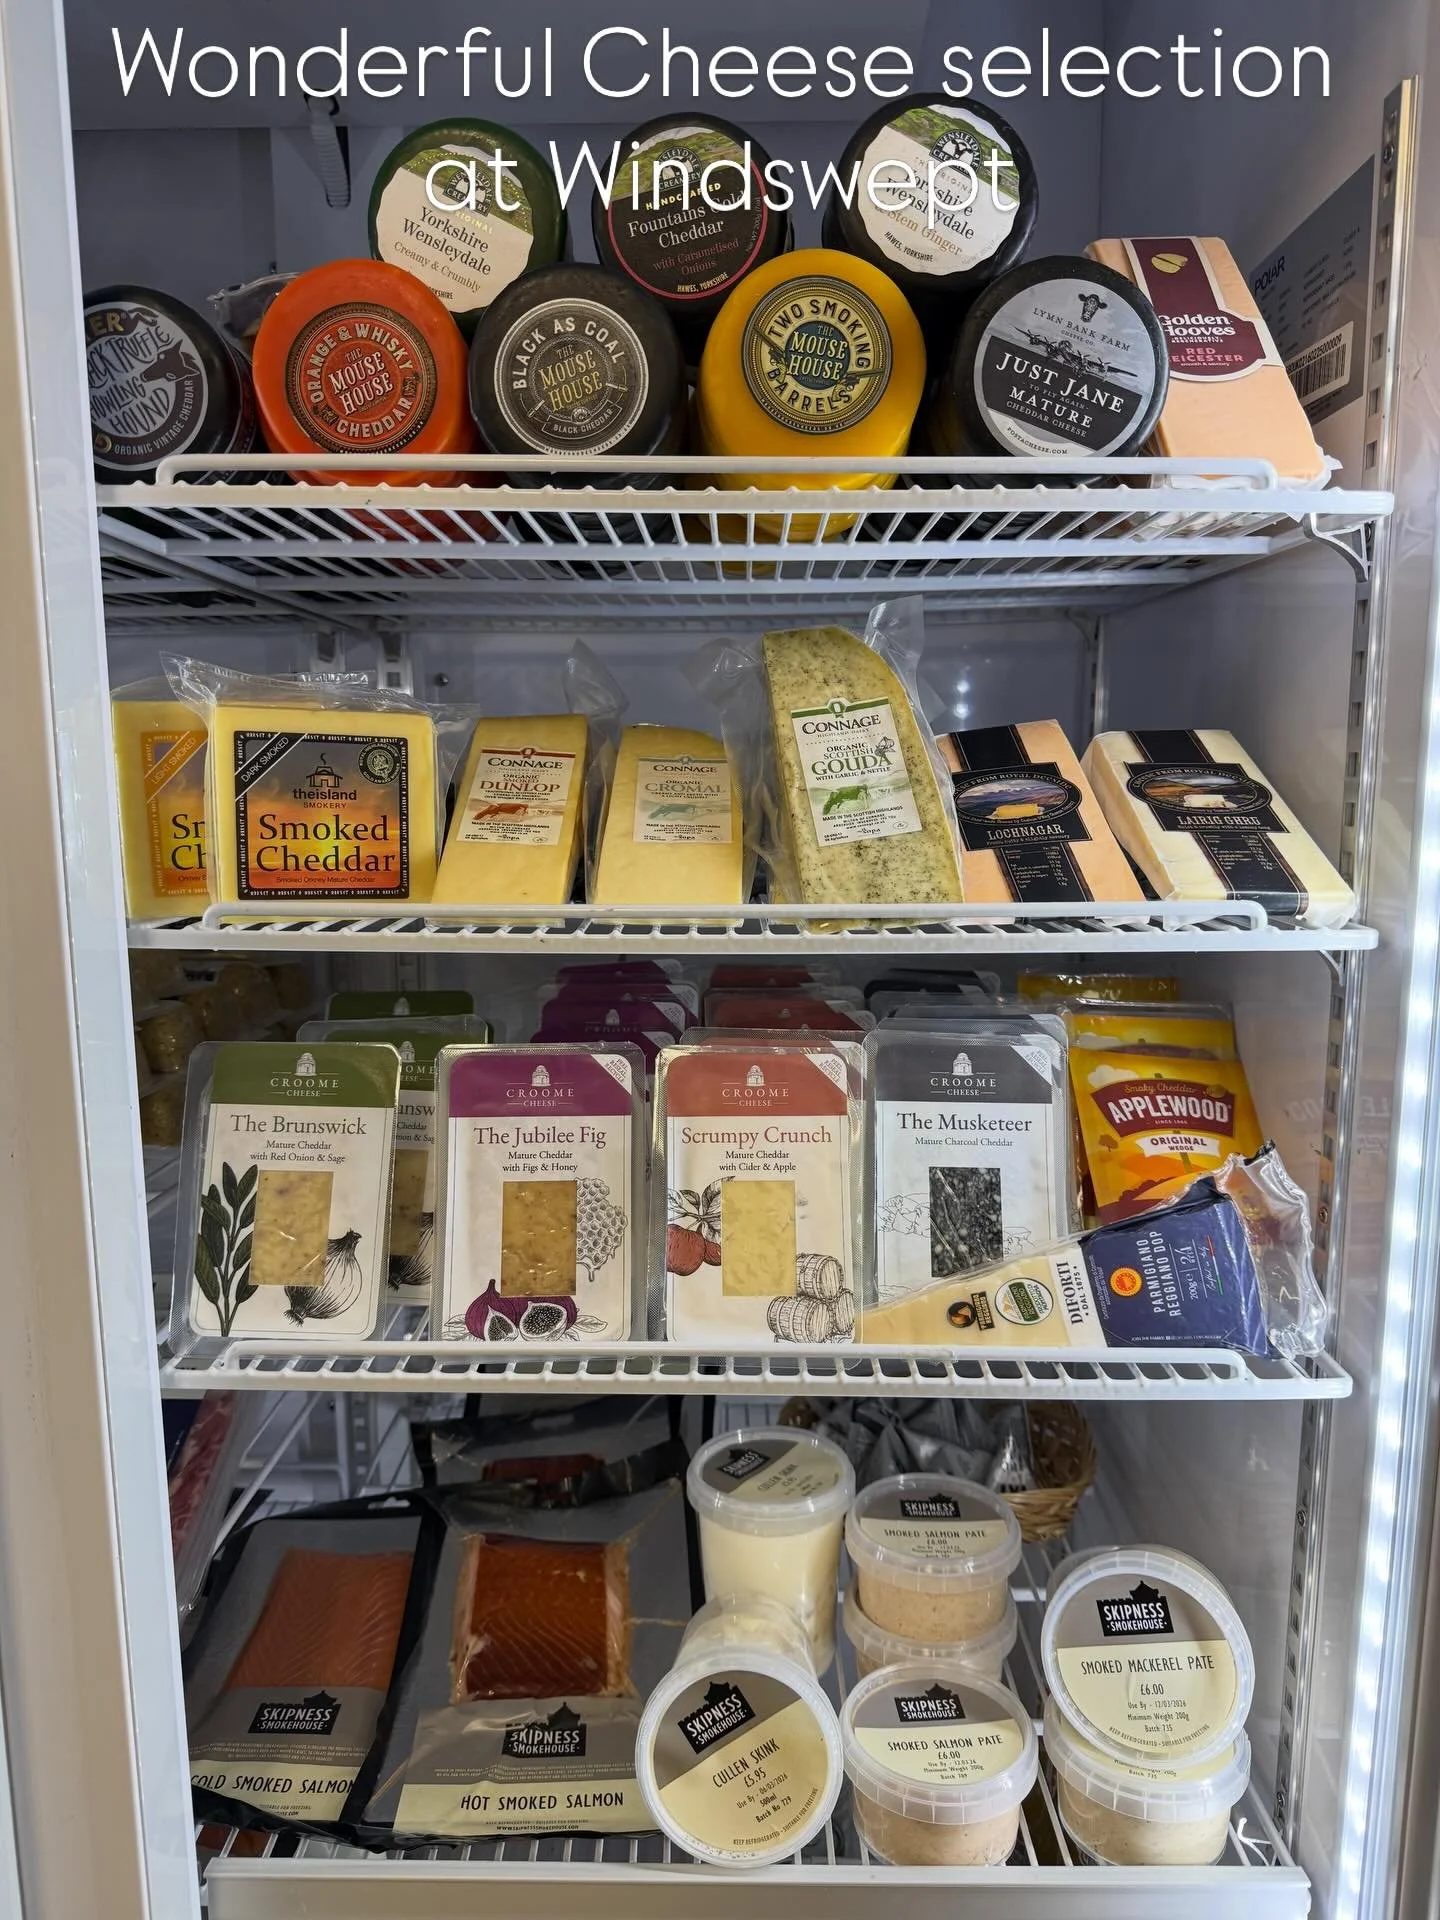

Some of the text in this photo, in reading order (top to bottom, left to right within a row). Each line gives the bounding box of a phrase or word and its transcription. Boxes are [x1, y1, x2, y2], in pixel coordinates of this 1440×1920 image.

[420, 206, 489, 254] Yorkshire
[627, 204, 706, 238] Fountains
[658, 219, 725, 248] Cheddar
[921, 224, 962, 256] Ginger
[403, 218, 492, 276] Wensleydale
[394, 241, 481, 293] Creamy & Crumbly
[653, 258, 676, 271] with
[1158, 313, 1230, 326] Golden
[768, 299, 871, 369] TWO SMOKING
[816, 325, 834, 337] THE
[1033, 307, 1131, 352] LYMN BANK FARM
[345, 347, 363, 363] THE
[512, 317, 625, 390] BLACK AS COAL
[556, 344, 574, 359] THE
[790, 331, 848, 360] MOUSE
[307, 323, 413, 404] ORANGE & WHISKY
[538, 349, 597, 390] MOUSE
[787, 354, 843, 381] HOUSE
[328, 352, 386, 395] MOUSE
[995, 352, 1125, 413] JUST JANE
[339, 372, 393, 416] HOUSE
[548, 371, 603, 413] HOUSE
[767, 367, 851, 413] BARRELS
[109, 388, 170, 435] HOUND
[1009, 386, 1093, 429] MATURE
[337, 397, 414, 438] CHEDDAR
[553, 408, 613, 434] BLACK CHEDDAR
[1006, 401, 1087, 437] CHEDDAR CHEESE
[114, 443, 153, 455] ORGANIC
[802, 714, 881, 735] CONNAGE
[823, 748, 874, 760] SCOTTISH
[826, 742, 868, 752] ORGANIC
[241, 736, 289, 783] DARK SMOKED
[488, 757, 563, 769] CONNAGE
[653, 765, 717, 773] CONNAGE
[811, 754, 893, 776] GOUDA
[480, 780, 560, 793] DUNLOP
[971, 775, 997, 785] FROM
[293, 789, 357, 800] theisland
[853, 810, 875, 818] SCOTTISH
[1176, 815, 1260, 826] LAIRIG GHRU
[259, 814, 389, 841] Smoked
[987, 824, 1064, 841] LOCHNAGAR
[256, 845, 395, 872] Cheddar
[270, 1078, 339, 1087] CROOME
[930, 1078, 997, 1087] CROOME
[1124, 1082, 1196, 1094] Smoky Cheddar
[286, 1089, 321, 1097] CHEESE
[506, 1088, 574, 1098] CROOME
[722, 1088, 789, 1098] CROOME
[1107, 1095, 1229, 1124] APPLEWOOD
[230, 1114, 367, 1136] The Brunswick
[897, 1112, 1033, 1131] The Musketeer
[266, 1140, 331, 1150] Mature Cheddar
[473, 1126, 607, 1149] The Jubilee Fig
[681, 1126, 832, 1149] Scrumpy Crunch
[915, 1137, 1013, 1147] Mature Charcoal Cheddar
[1150, 1136, 1208, 1146] ORIGINAL
[250, 1152, 346, 1164] with Red Onion & Sage
[508, 1151, 573, 1160] Mature Cheddar
[725, 1150, 789, 1159] Mature Cheddar
[502, 1164, 520, 1172] with
[522, 1164, 539, 1173] Figs
[551, 1163, 578, 1173] Honey
[719, 1163, 797, 1173] with Cider & Apple
[1074, 1272, 1084, 1292] 1875
[1136, 1239, 1166, 1313] PARMIGIANO
[1149, 1231, 1182, 1317] REGGIANO DOP
[1056, 1262, 1083, 1325] DIFORTI
[905, 1502, 955, 1511] SKIPNESS
[884, 1529, 920, 1538] SMOKED
[924, 1529, 960, 1538] SALMON
[1103, 1602, 1164, 1621] SKIPNESS
[1110, 1619, 1165, 1632] SMOKEHOUSE
[1080, 1655, 1215, 1675] SMOKED MACKEREL PATE
[1140, 1683, 1164, 1696] £6.00
[260, 1707, 333, 1721] SKIPNESS
[901, 1699, 957, 1712] SKIPNESS
[907, 1710, 957, 1719] SMOKEHOUSE
[1128, 1701, 1138, 1709] Use
[686, 1693, 743, 1737] SKIPNESS
[1154, 1713, 1174, 1721] Weight
[1175, 1712, 1190, 1721] 200g
[260, 1722, 324, 1730] SMOKEHOUSE
[698, 1709, 746, 1745] SMOKEHOUSE
[510, 1729, 580, 1744] SKIPNESS
[887, 1735, 1004, 1751] SMOKED SALMON PATE
[512, 1742, 576, 1754] SMOKEHOUSE
[938, 1752, 961, 1760] £6.00
[712, 1738, 780, 1788] CULLEN SKINK
[232, 1775, 293, 1794] SMOKED
[744, 1767, 767, 1788] £5.95
[461, 1791, 624, 1811] HOT SMOKED SALMON
